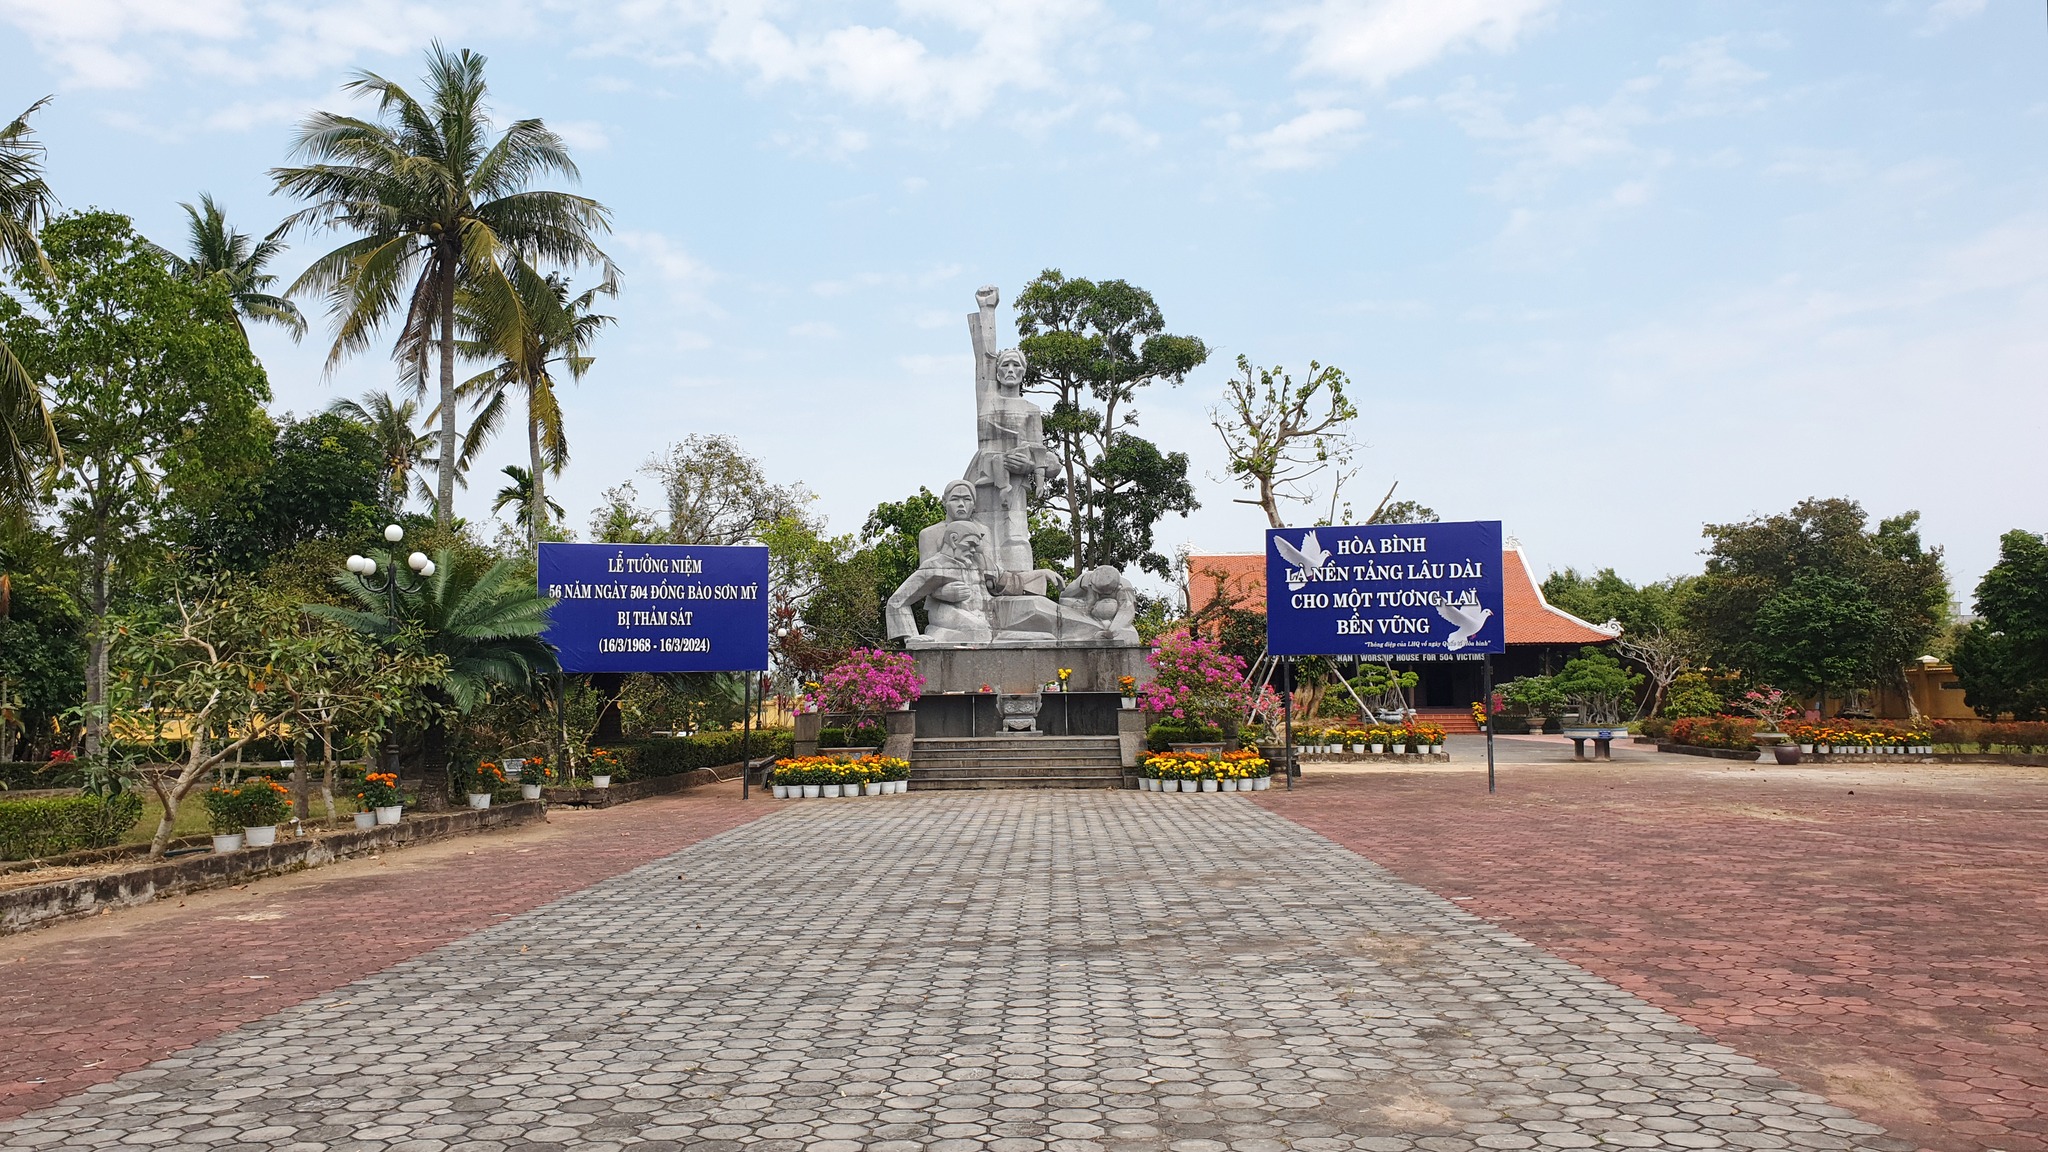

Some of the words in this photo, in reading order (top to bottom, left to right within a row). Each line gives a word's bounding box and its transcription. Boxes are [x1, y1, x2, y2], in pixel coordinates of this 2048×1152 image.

[1337, 535, 1376, 555] HÒA
[1379, 534, 1427, 554] BÌNH
[608, 550, 624, 573] LỄ
[626, 553, 669, 573] TƯỞNG
[671, 555, 703, 577] NIỆM
[1285, 563, 1308, 583] LÀ
[1311, 560, 1350, 582] NỀN
[1353, 559, 1403, 581] TẢNG
[1407, 560, 1445, 580] LÂU
[1449, 558, 1483, 578] DÀI
[549, 584, 562, 598] 56
[564, 580, 592, 599] NĂM
[594, 580, 628, 599] NGÀY
[630, 585, 648, 599] 504
[650, 578, 685, 599] ĐỒNG
[687, 581, 712, 600] BÀO
[714, 583, 738, 600] SƠN
[740, 582, 758, 600] MỸ
[1291, 593, 1329, 609] CHO
[1333, 588, 1373, 611] MỘT
[1376, 589, 1442, 607] TƯƠNG
[617, 611, 630, 630] BỊ
[632, 605, 668, 626] THẢM
[670, 606, 693, 626] SÁT
[1336, 612, 1373, 634] BỀN
[1377, 614, 1430, 634] VỮNG
[599, 638, 651, 654] (16/3/1968
[660, 638, 711, 654] 16/3/2024)
[1396, 654, 1420, 662] HOUSE
[1457, 653, 1485, 661] VICTIMS
